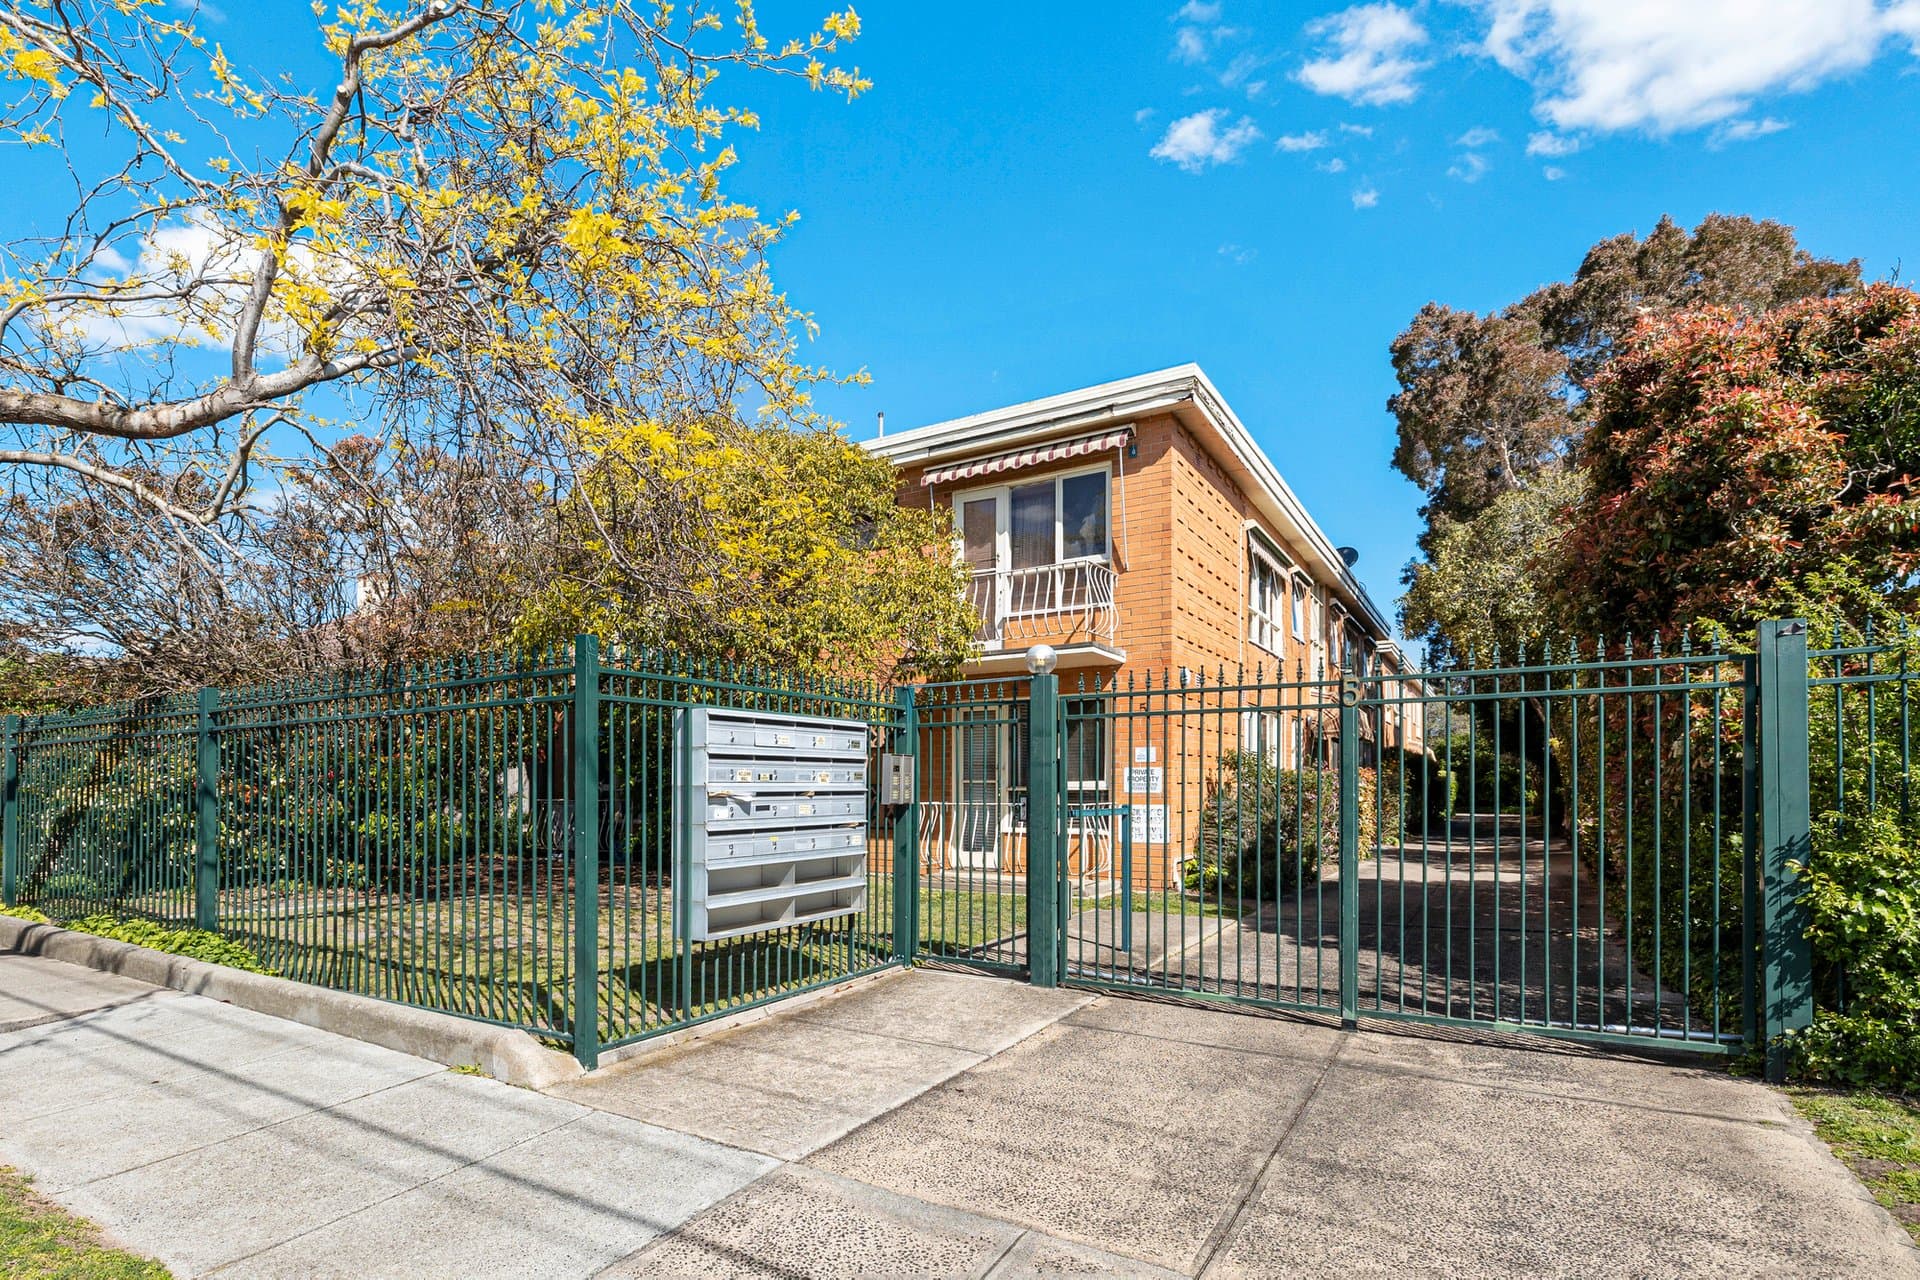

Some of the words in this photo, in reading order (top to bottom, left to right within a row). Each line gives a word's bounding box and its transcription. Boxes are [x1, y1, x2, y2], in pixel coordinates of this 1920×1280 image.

[1343, 676, 1361, 706] 5
[1131, 768, 1155, 776] PRIVAE
[1127, 775, 1160, 783] PROPETY
